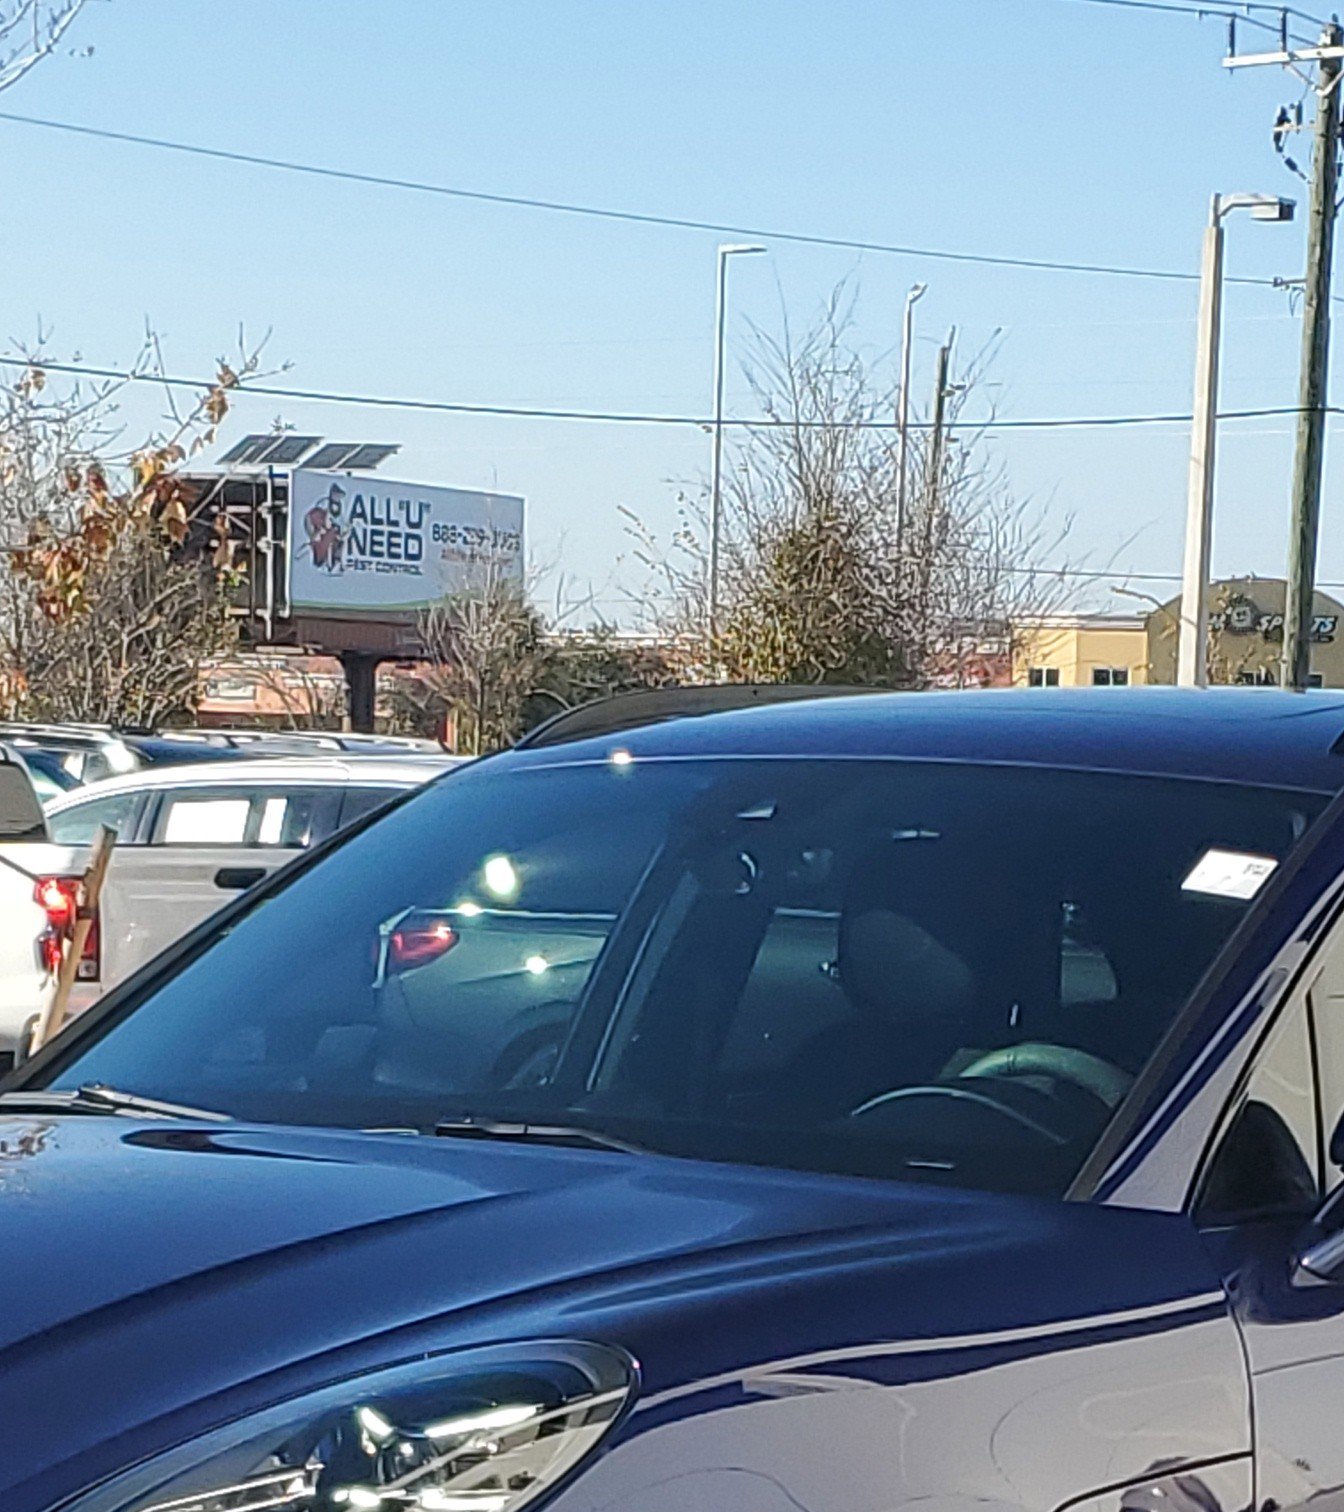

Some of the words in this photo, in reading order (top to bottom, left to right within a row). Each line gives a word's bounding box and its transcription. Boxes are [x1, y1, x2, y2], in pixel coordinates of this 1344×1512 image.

[349, 494, 399, 527] ALL
[347, 528, 423, 562] NEED
[1258, 614, 1338, 635] SPTS
